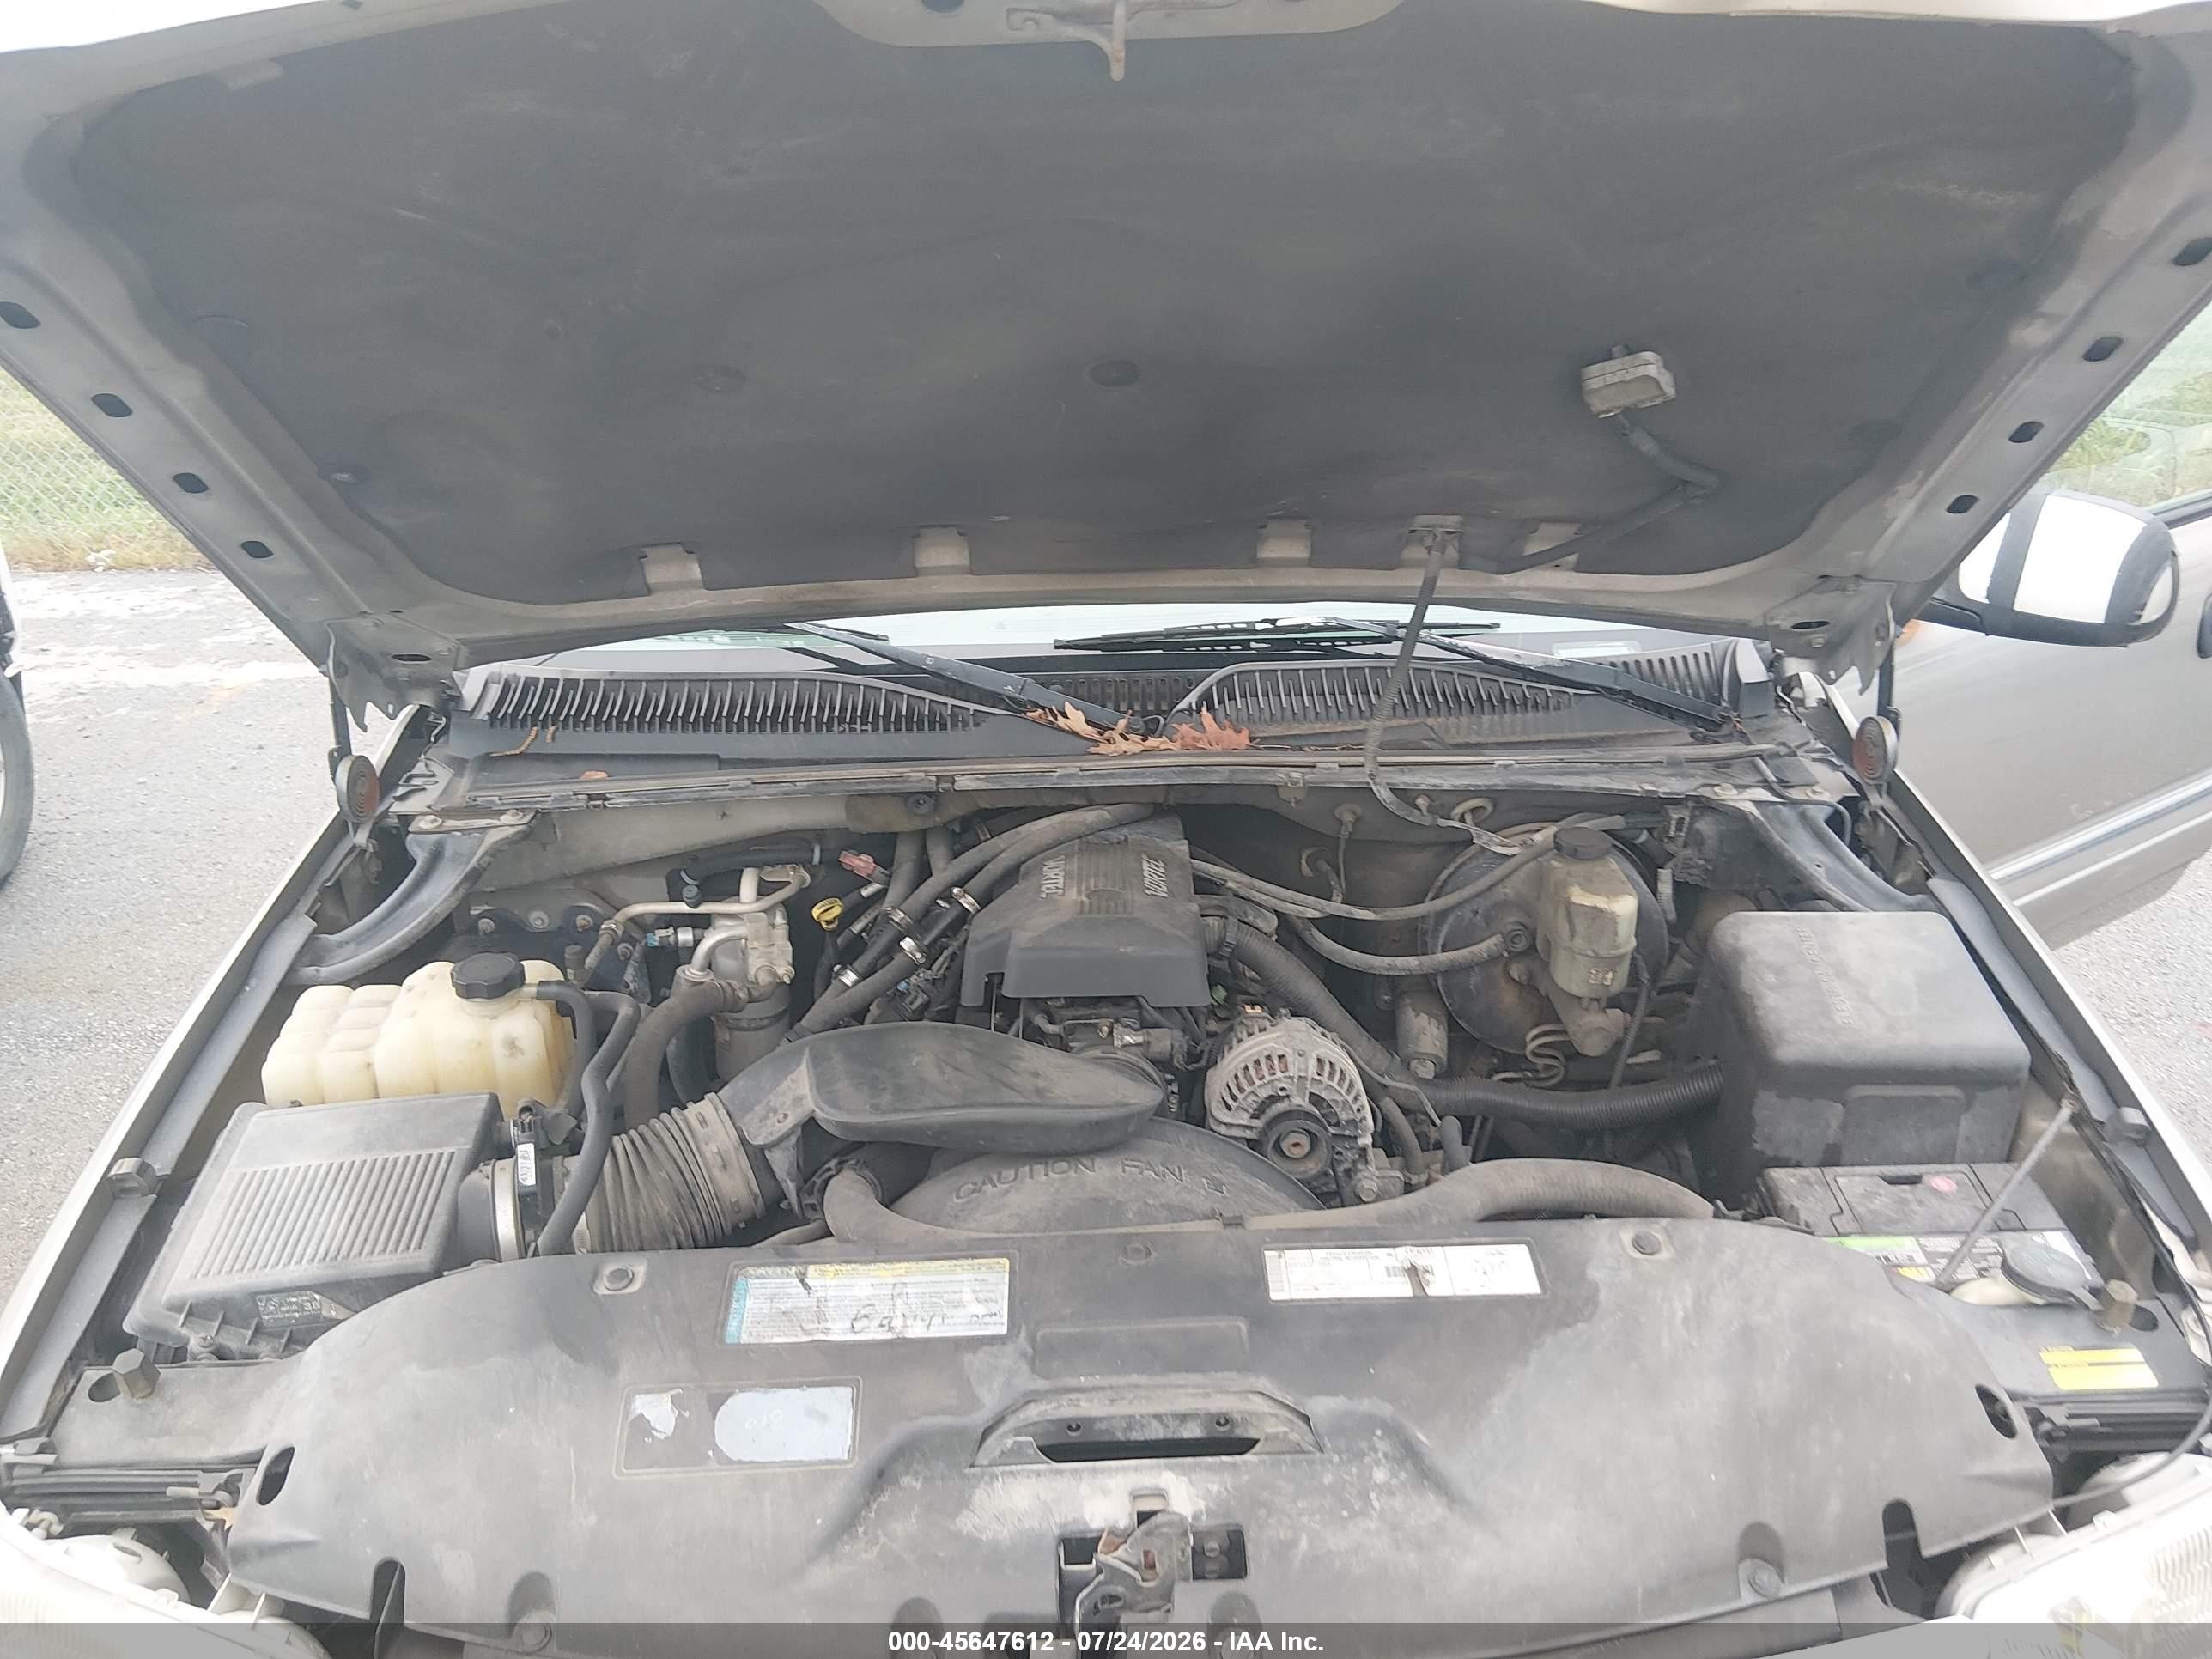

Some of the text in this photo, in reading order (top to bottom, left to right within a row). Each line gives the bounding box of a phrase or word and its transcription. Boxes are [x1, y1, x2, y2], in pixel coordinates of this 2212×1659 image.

[1039, 854, 1066, 899] VORTEC
[1140, 853, 1169, 898] VORTEC
[953, 1158, 1185, 1201] CAUTION FAN
